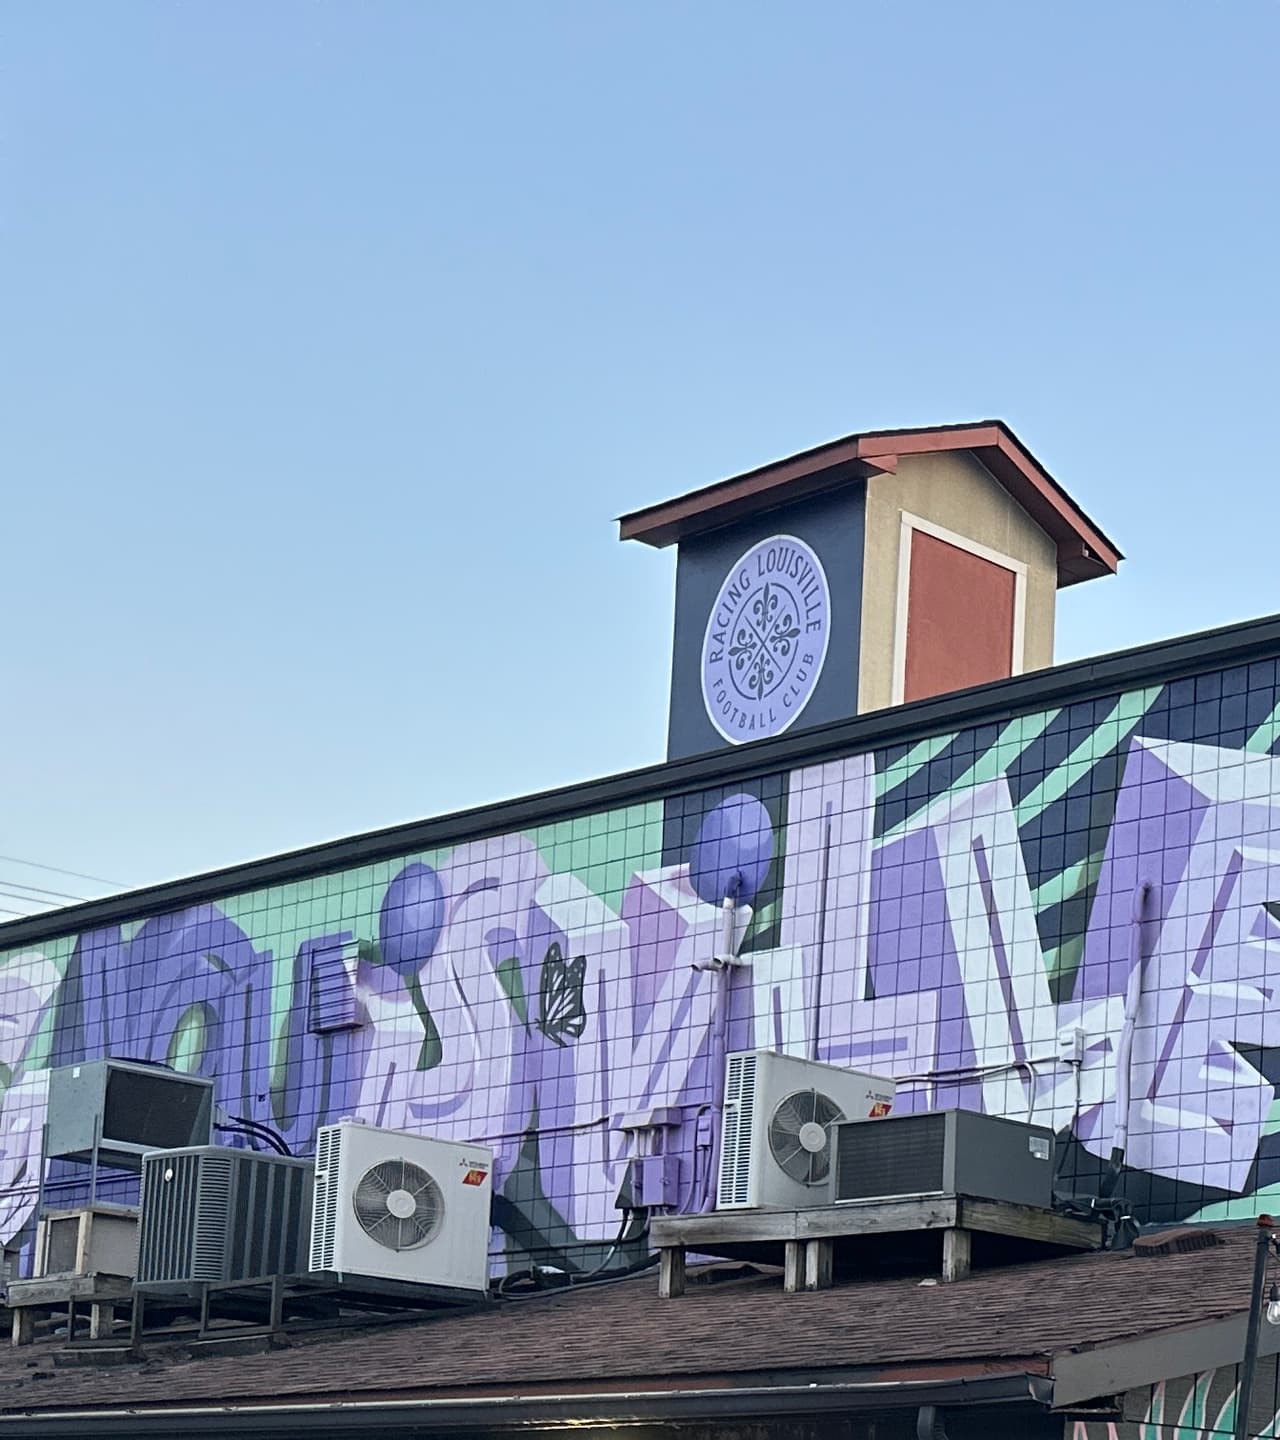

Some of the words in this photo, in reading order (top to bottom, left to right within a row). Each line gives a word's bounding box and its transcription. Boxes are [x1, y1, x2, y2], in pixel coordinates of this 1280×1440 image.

[709, 569, 751, 664] RACING
[758, 547, 821, 633] LOUISVILLE
[713, 678, 776, 730] FOOTBALL
[783, 653, 813, 707] CLUB
